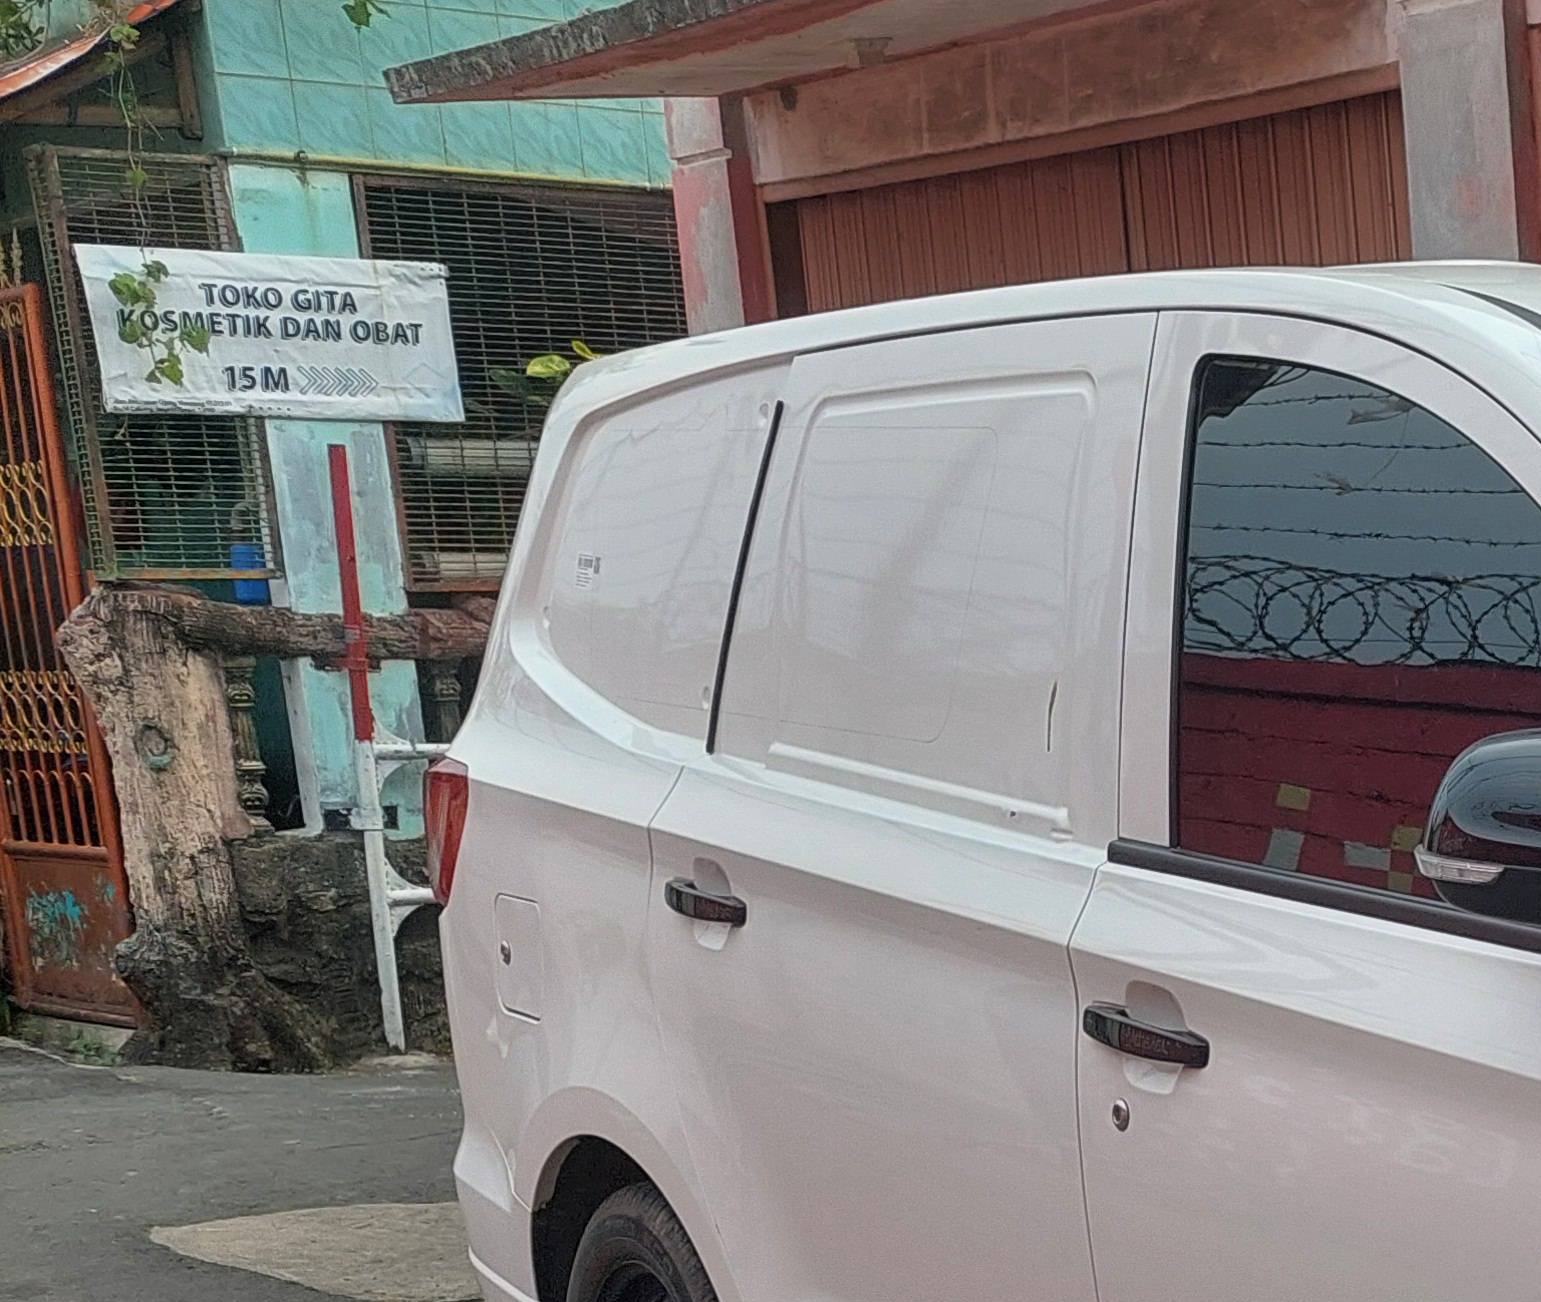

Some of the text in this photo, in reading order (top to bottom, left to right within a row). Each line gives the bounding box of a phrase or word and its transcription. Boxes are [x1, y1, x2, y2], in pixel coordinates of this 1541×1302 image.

[200, 283, 358, 314] TOKO GITA
[117, 308, 423, 346] KOSMETIK DAN OBAT
